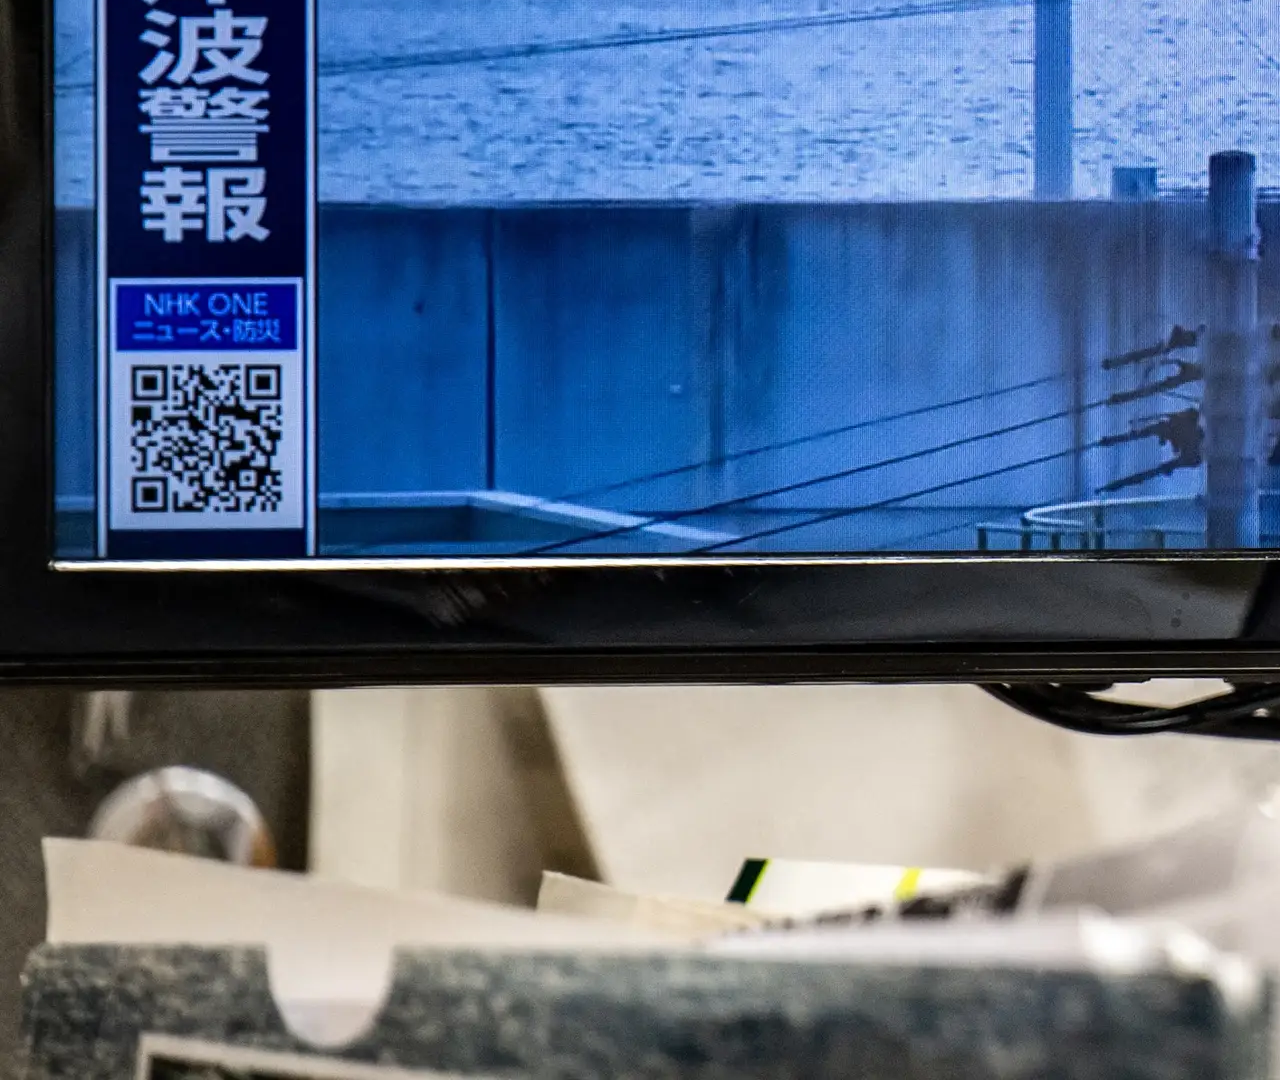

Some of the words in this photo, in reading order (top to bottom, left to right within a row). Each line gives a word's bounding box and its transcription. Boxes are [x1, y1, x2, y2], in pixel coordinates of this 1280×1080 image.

[144, 292, 199, 316] NHK
[207, 292, 269, 316] ONE
[132, 318, 281, 344] ニュース・防災
